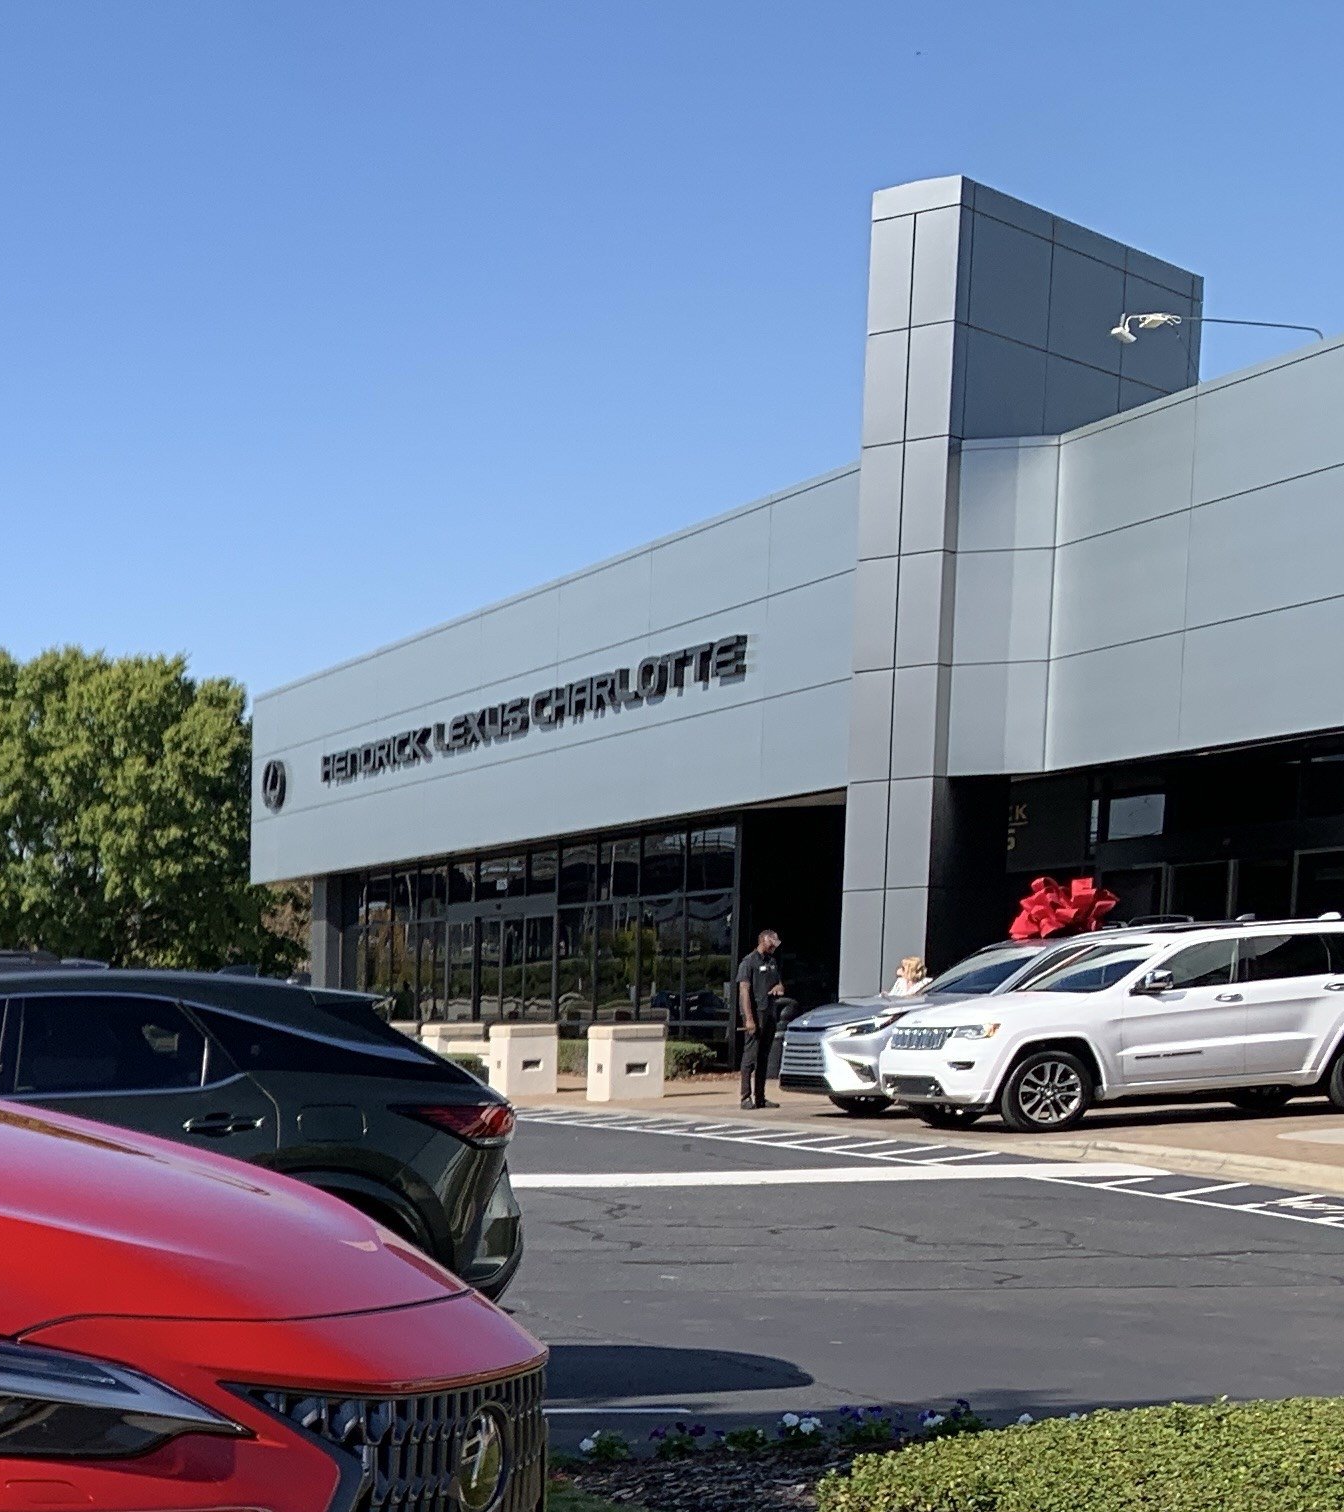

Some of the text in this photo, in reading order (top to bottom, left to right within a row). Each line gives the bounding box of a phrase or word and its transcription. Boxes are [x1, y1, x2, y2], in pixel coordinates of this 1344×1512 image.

[321, 635, 747, 783] HENDRICK LEXUS CHARLOTTE
